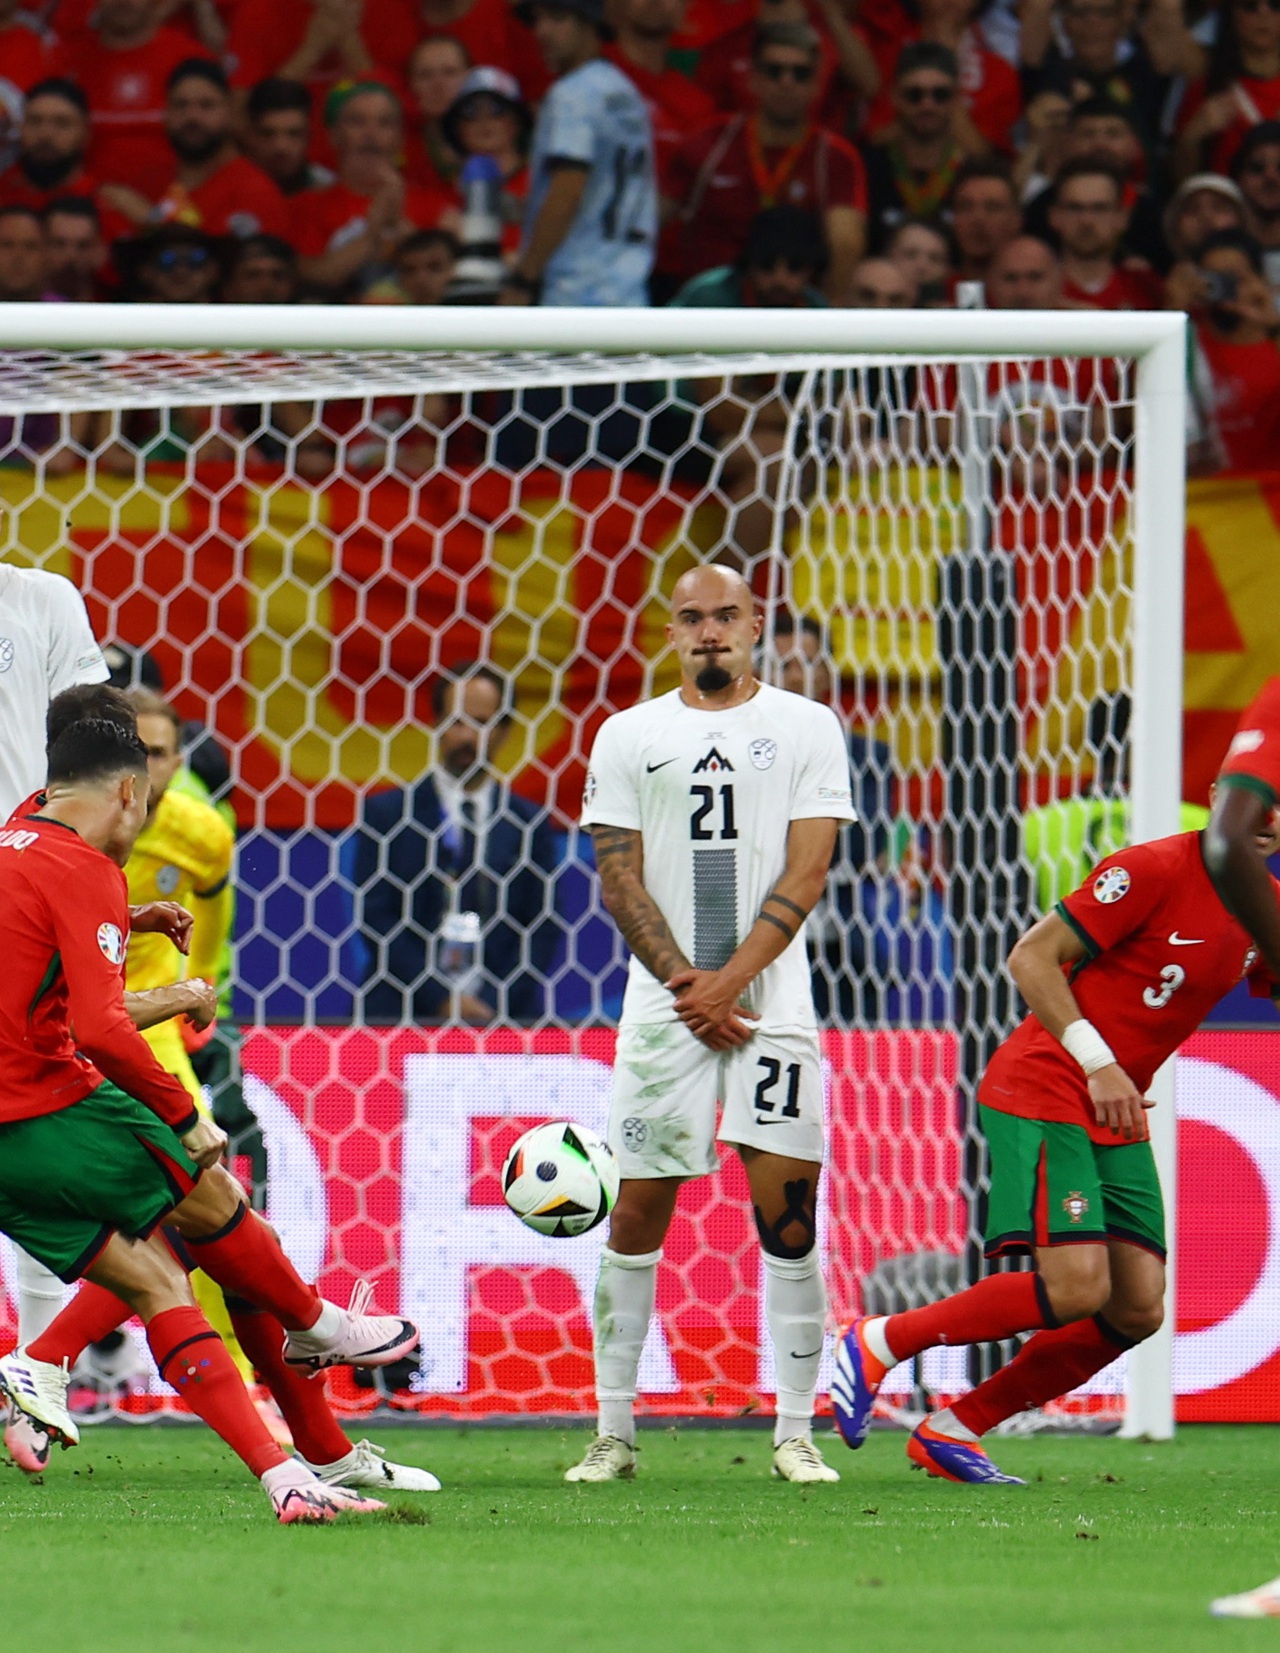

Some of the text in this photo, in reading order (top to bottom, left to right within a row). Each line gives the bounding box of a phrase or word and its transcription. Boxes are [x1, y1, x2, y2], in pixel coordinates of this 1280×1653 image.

[690, 784, 738, 840] 21
[1142, 964, 1186, 1010] 3
[754, 1055, 802, 1118] 21
